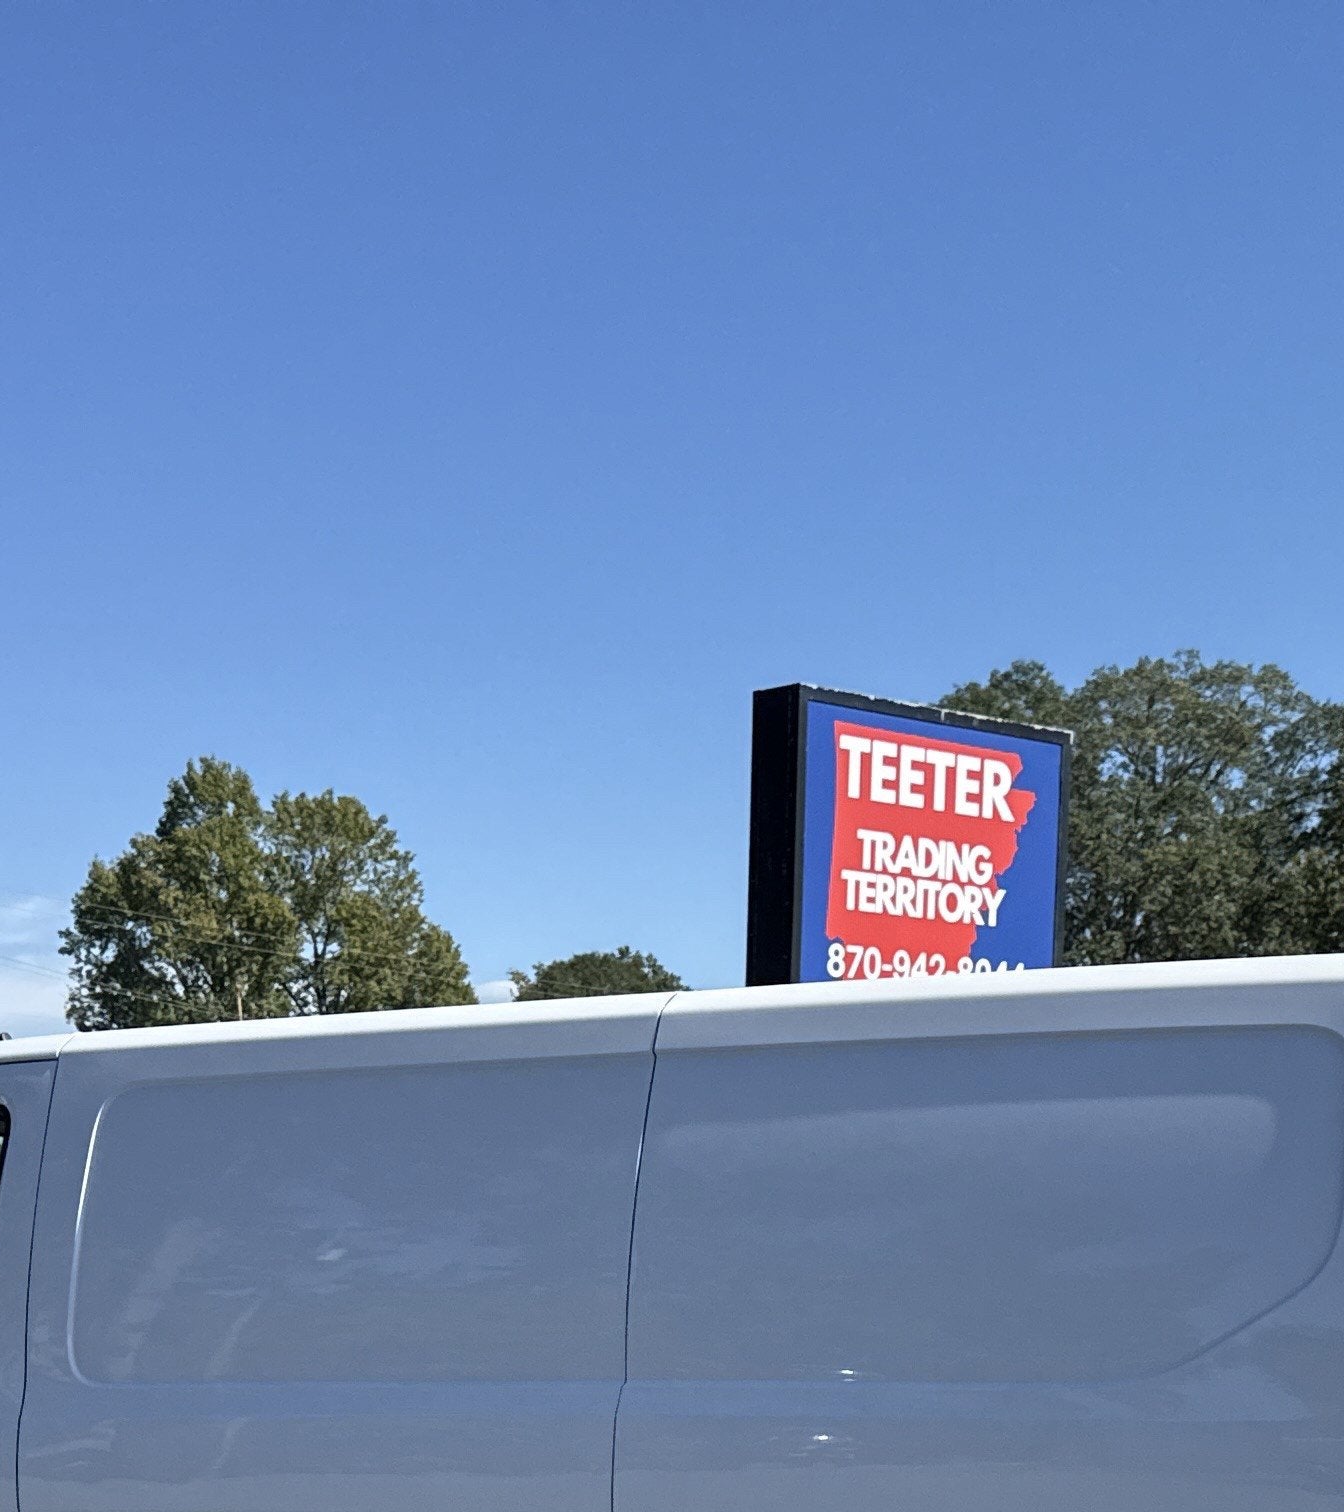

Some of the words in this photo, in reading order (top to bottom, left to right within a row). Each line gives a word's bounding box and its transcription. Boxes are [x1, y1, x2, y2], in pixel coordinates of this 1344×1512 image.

[839, 734, 1015, 822] TEETER
[856, 829, 994, 885] TRADING
[840, 869, 1006, 927] TERRITORY
